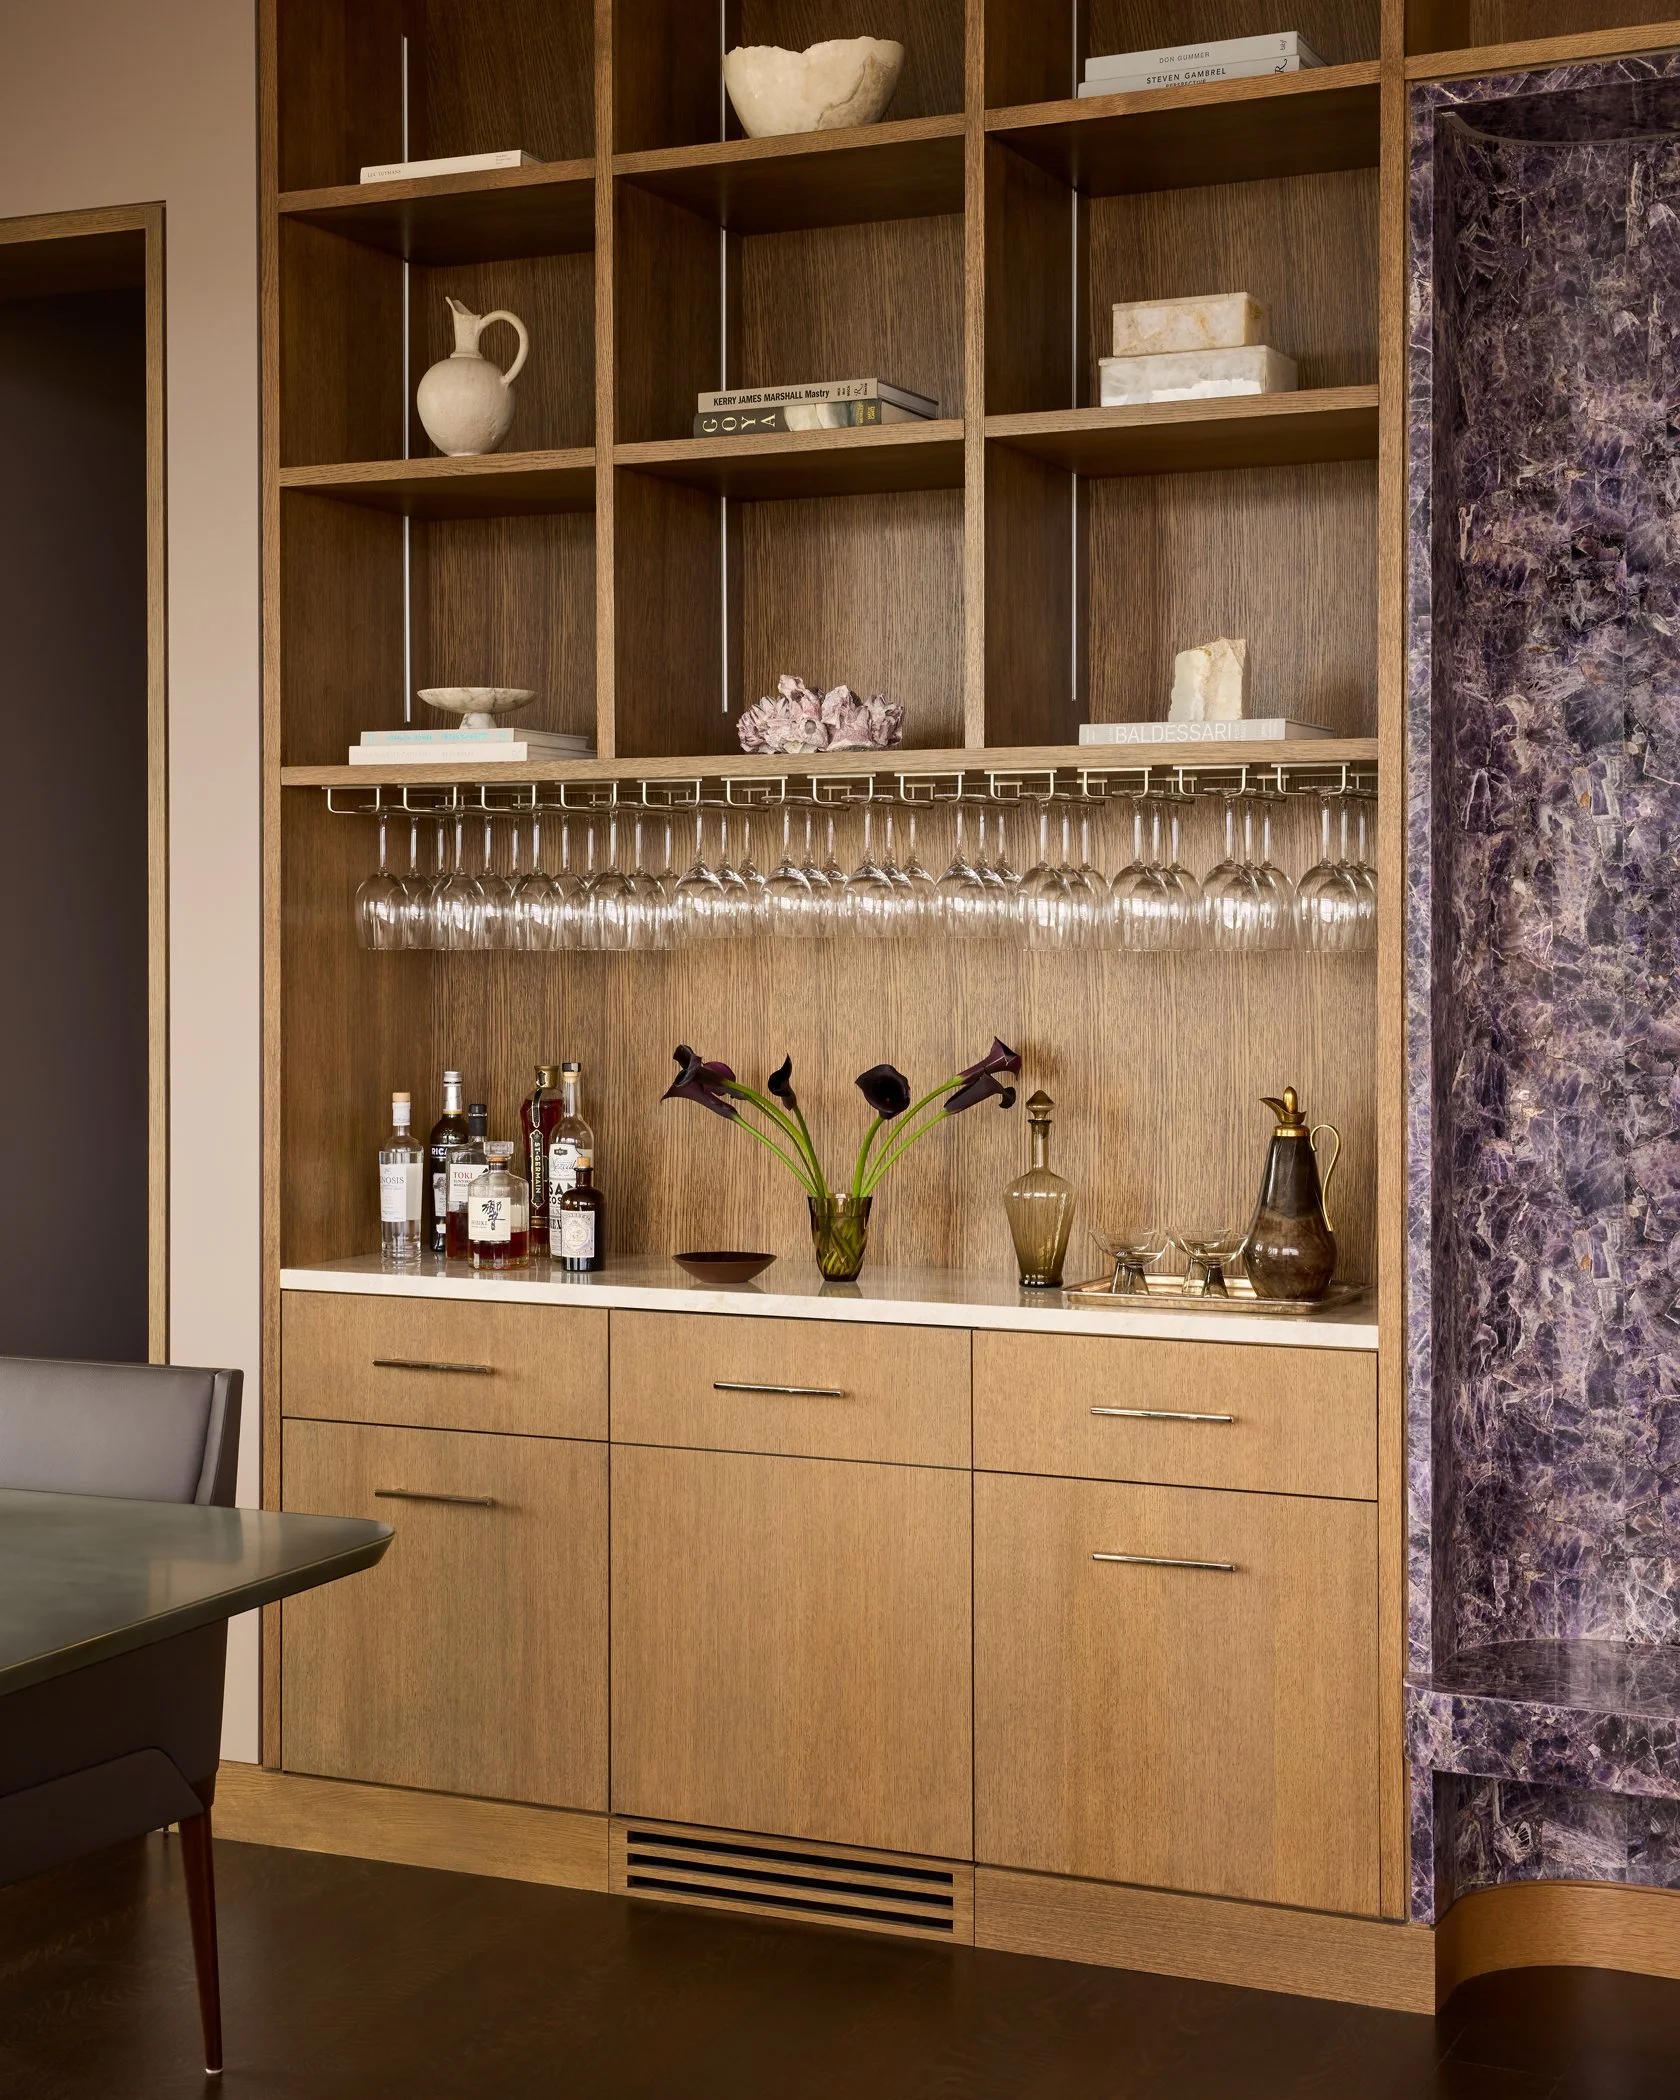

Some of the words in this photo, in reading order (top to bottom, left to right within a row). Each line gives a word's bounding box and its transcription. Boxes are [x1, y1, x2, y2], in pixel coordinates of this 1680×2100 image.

[1177, 52, 1210, 61] GUMMER
[1146, 73, 1180, 84] STEVEN
[1184, 68, 1227, 79] GAMBREL
[713, 397, 737, 406] KERRY
[738, 394, 762, 405] JAMES
[764, 391, 803, 402] MARSHALL
[805, 389, 830, 399] Mastry
[702, 413, 776, 433] GOYA
[1115, 722, 1231, 743] BALDESSARI
[452, 1171, 473, 1179] TOKI
